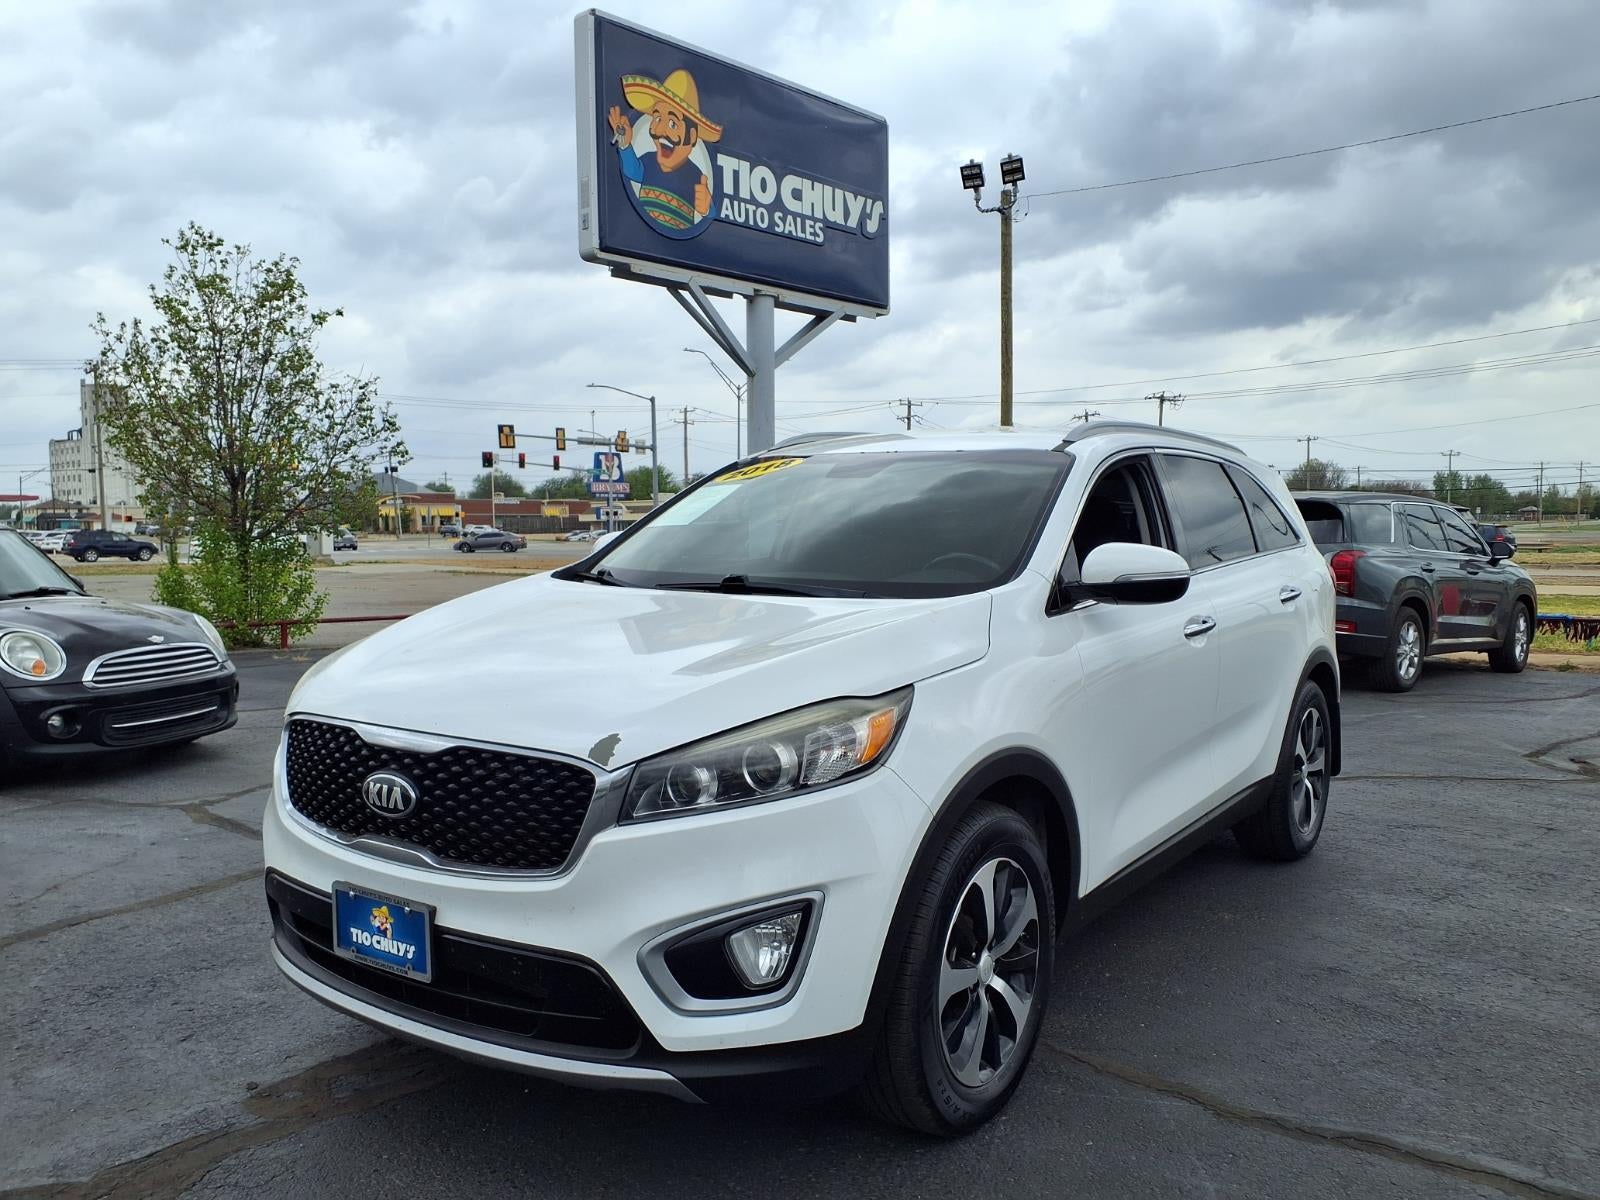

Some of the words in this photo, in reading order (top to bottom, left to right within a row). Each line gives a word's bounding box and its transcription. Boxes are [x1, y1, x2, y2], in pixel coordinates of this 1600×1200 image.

[717, 153, 777, 205] TIO
[781, 174, 884, 233] CHUY'S
[720, 198, 768, 229] AUTO
[775, 211, 824, 243] SALES
[368, 781, 404, 810] KIA
[350, 927, 371, 946] TIO
[372, 934, 416, 959] CHUY'S
